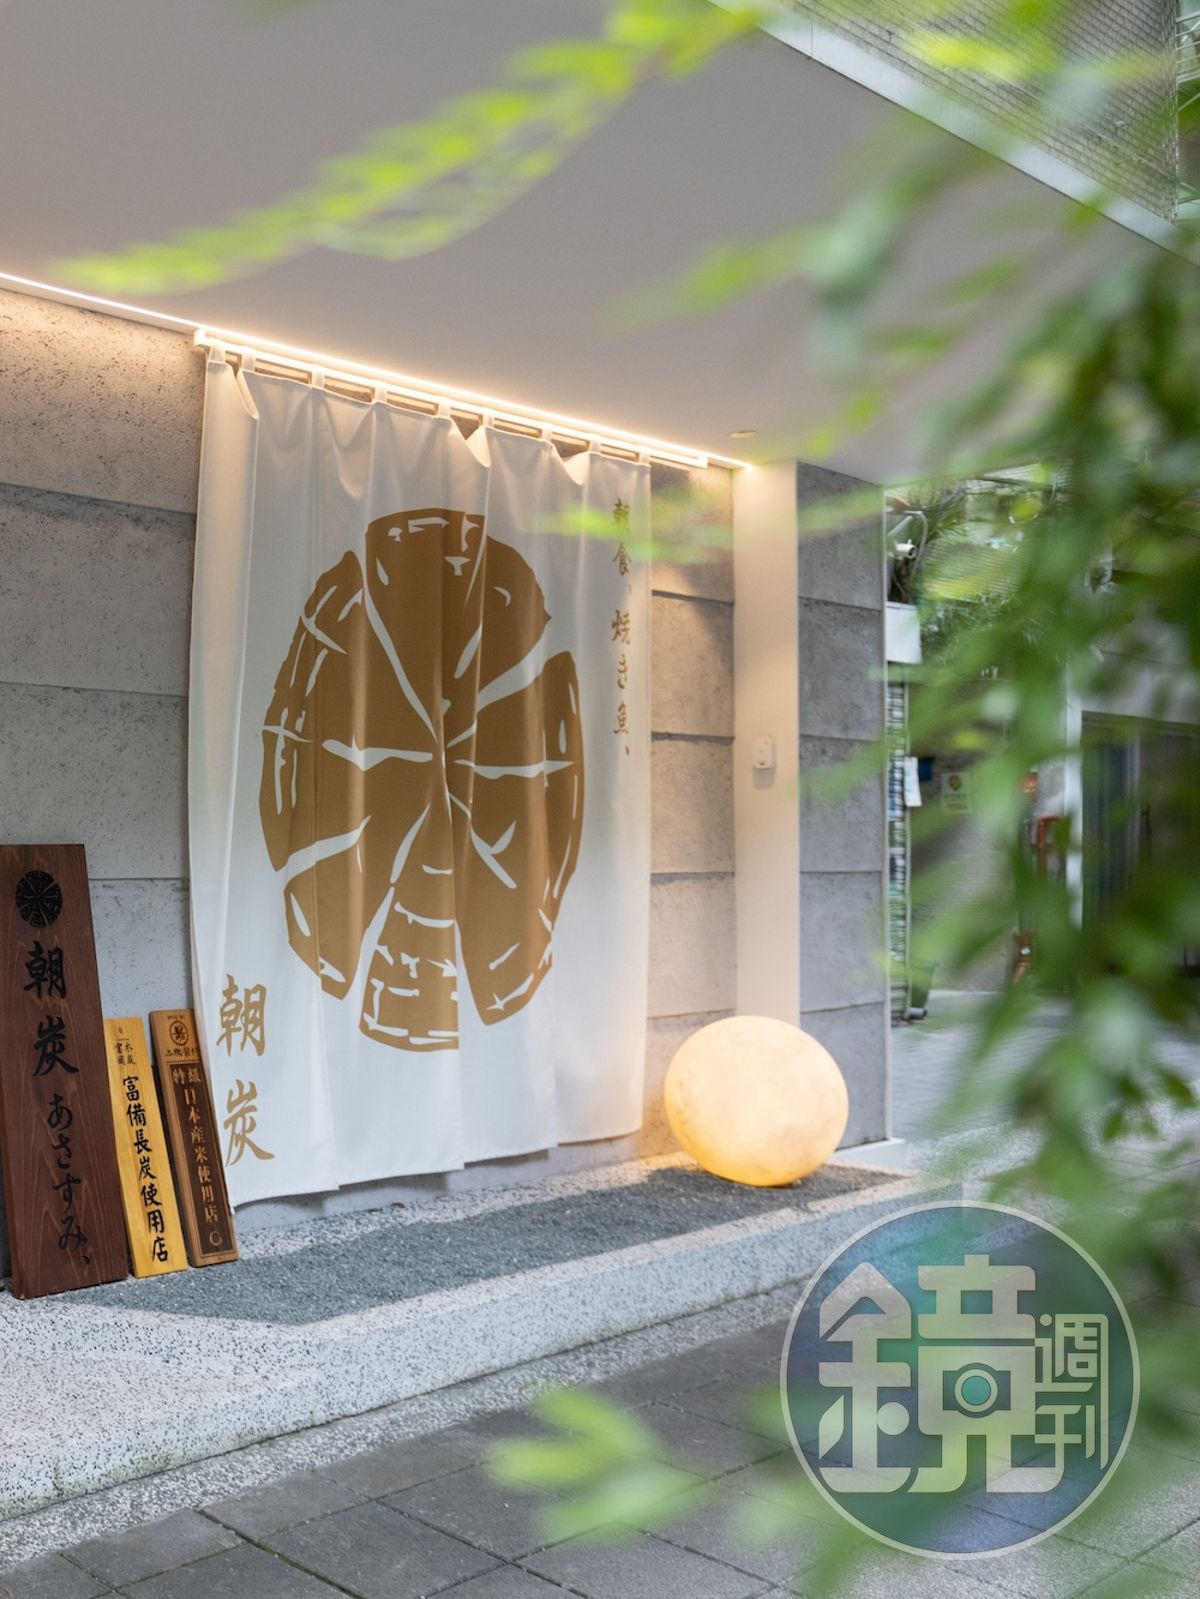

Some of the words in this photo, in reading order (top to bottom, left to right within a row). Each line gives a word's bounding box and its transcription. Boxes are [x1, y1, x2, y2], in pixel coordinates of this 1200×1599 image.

[216, 974, 275, 1168] 朝炭
[122, 1075, 170, 1263] 富備長炭使用店
